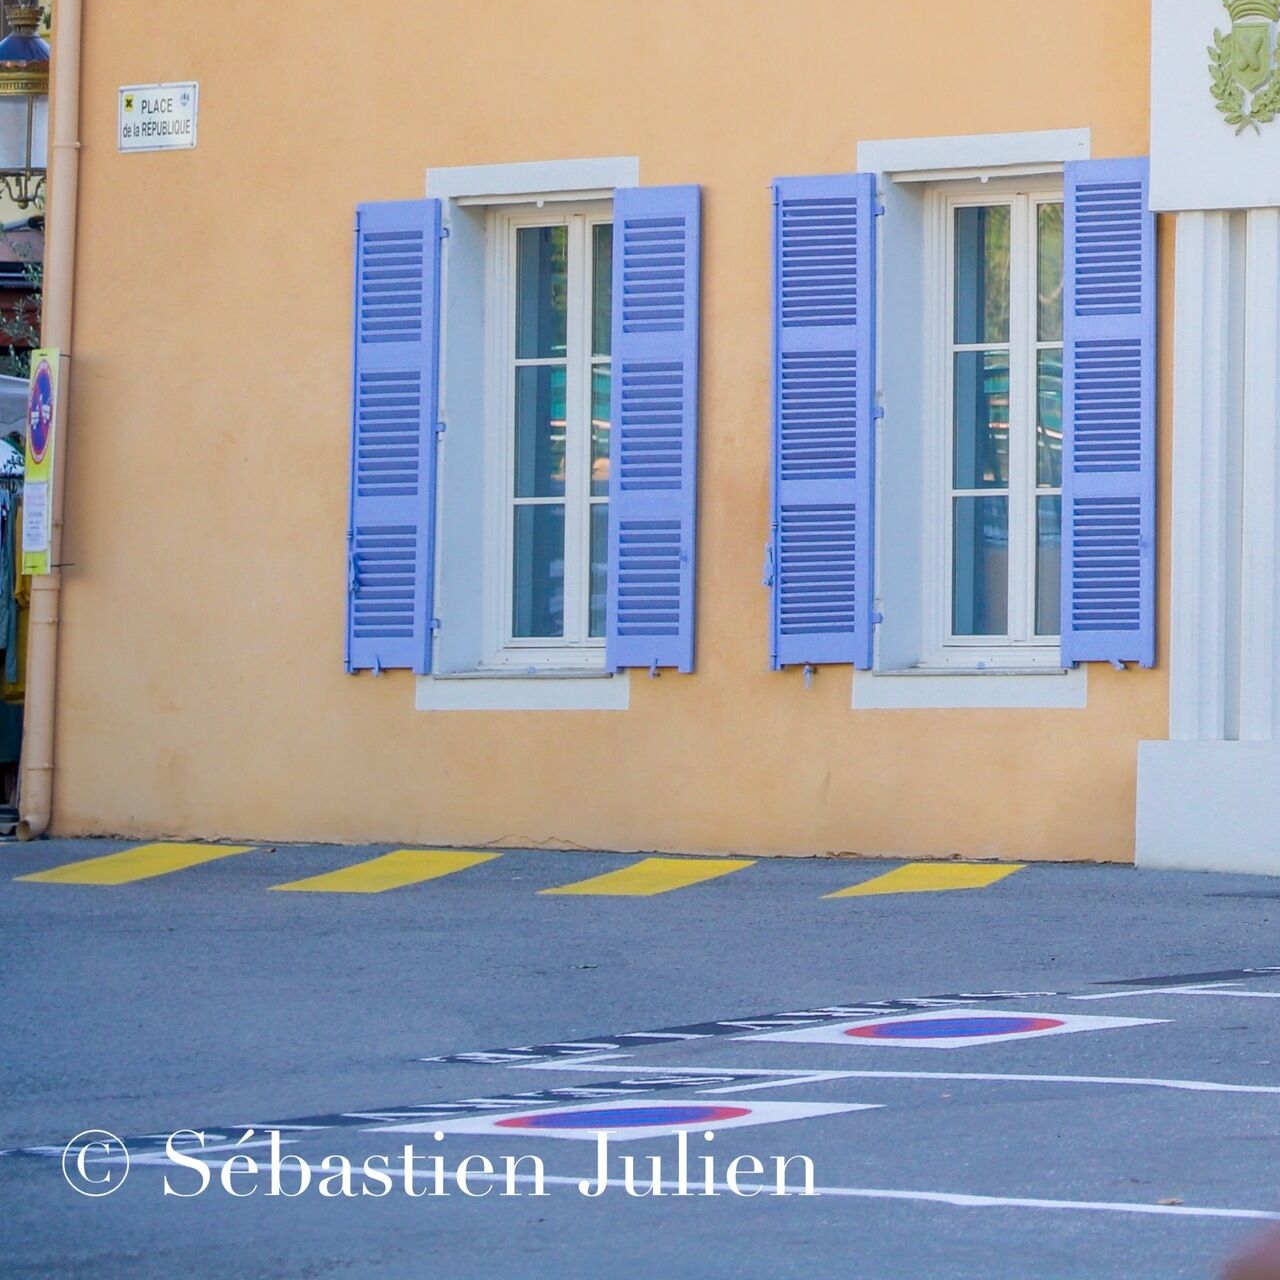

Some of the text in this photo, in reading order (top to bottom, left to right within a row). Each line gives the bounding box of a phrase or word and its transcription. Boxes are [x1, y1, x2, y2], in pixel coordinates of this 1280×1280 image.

[141, 98, 173, 114] PLACE
[122, 118, 190, 138] de la RÉPUBLIQUE
